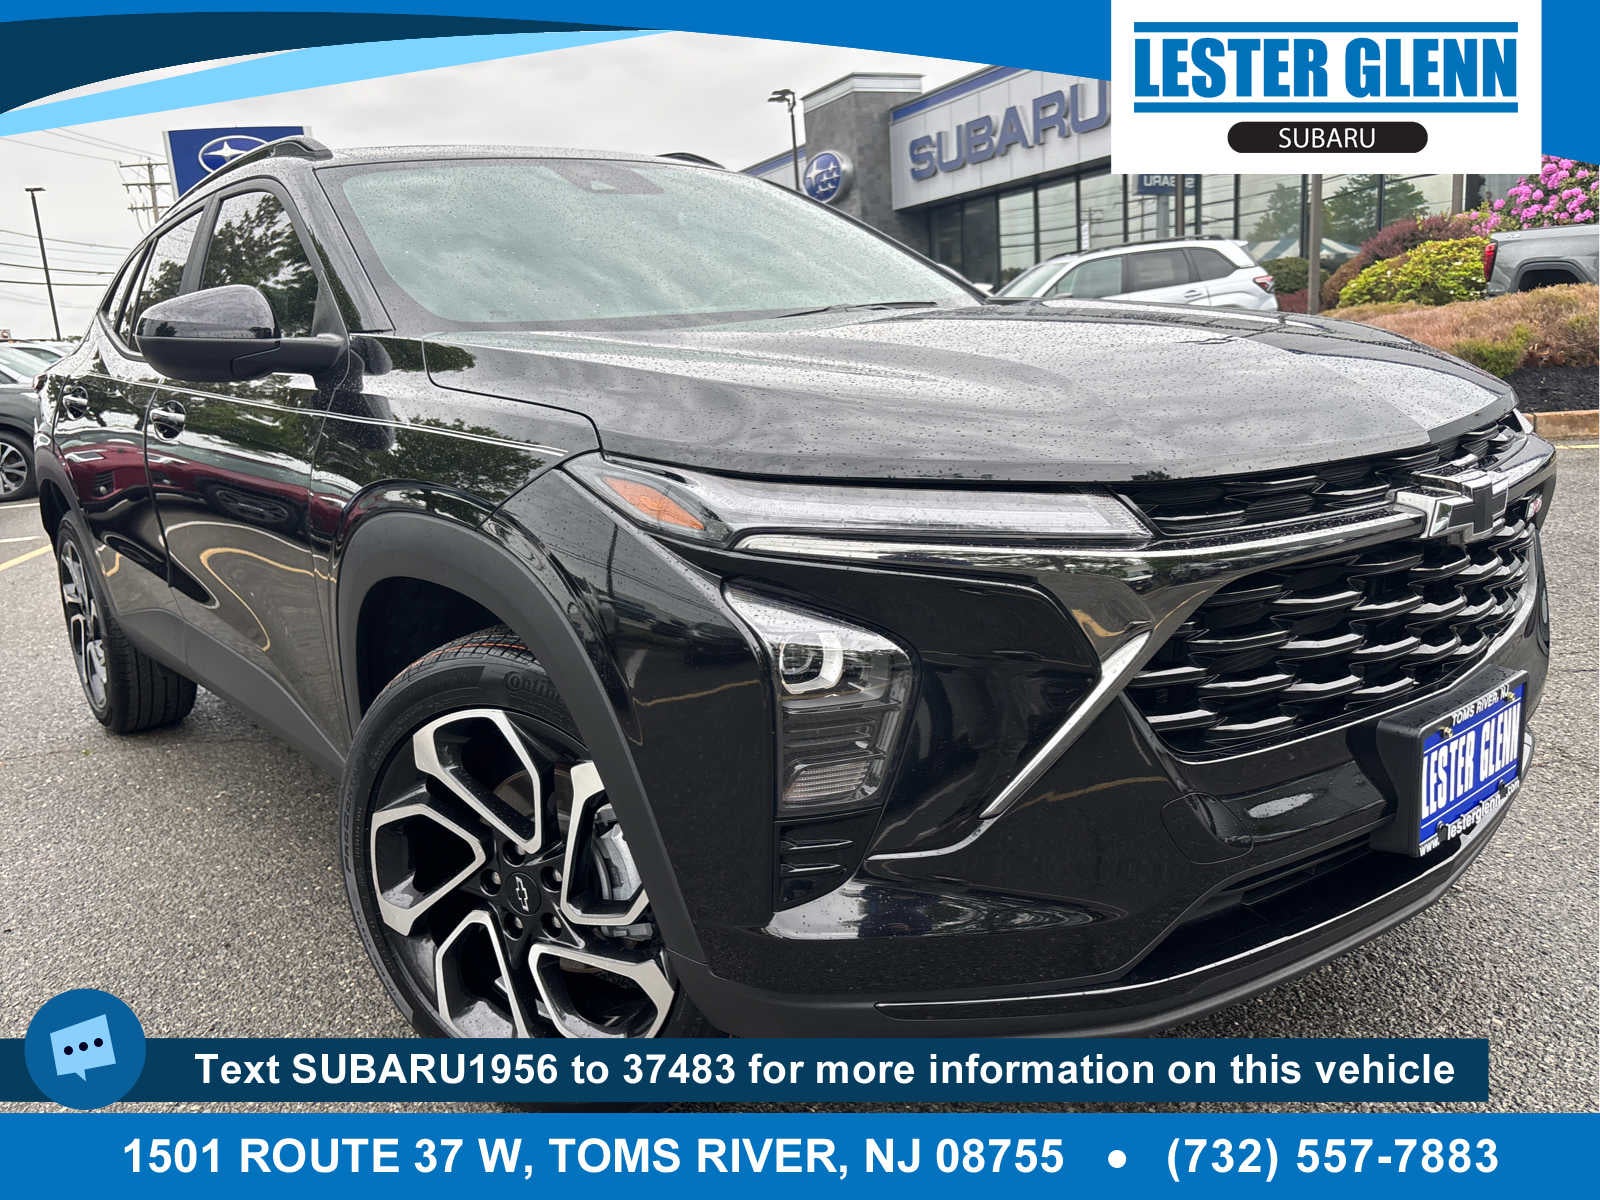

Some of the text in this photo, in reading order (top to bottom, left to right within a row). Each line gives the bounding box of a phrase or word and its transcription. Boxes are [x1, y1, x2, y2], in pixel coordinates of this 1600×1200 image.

[909, 79, 1109, 182] SUBARU
[1421, 702, 1521, 820] LESTER GLENN
[1451, 704, 1475, 726] TOMS
